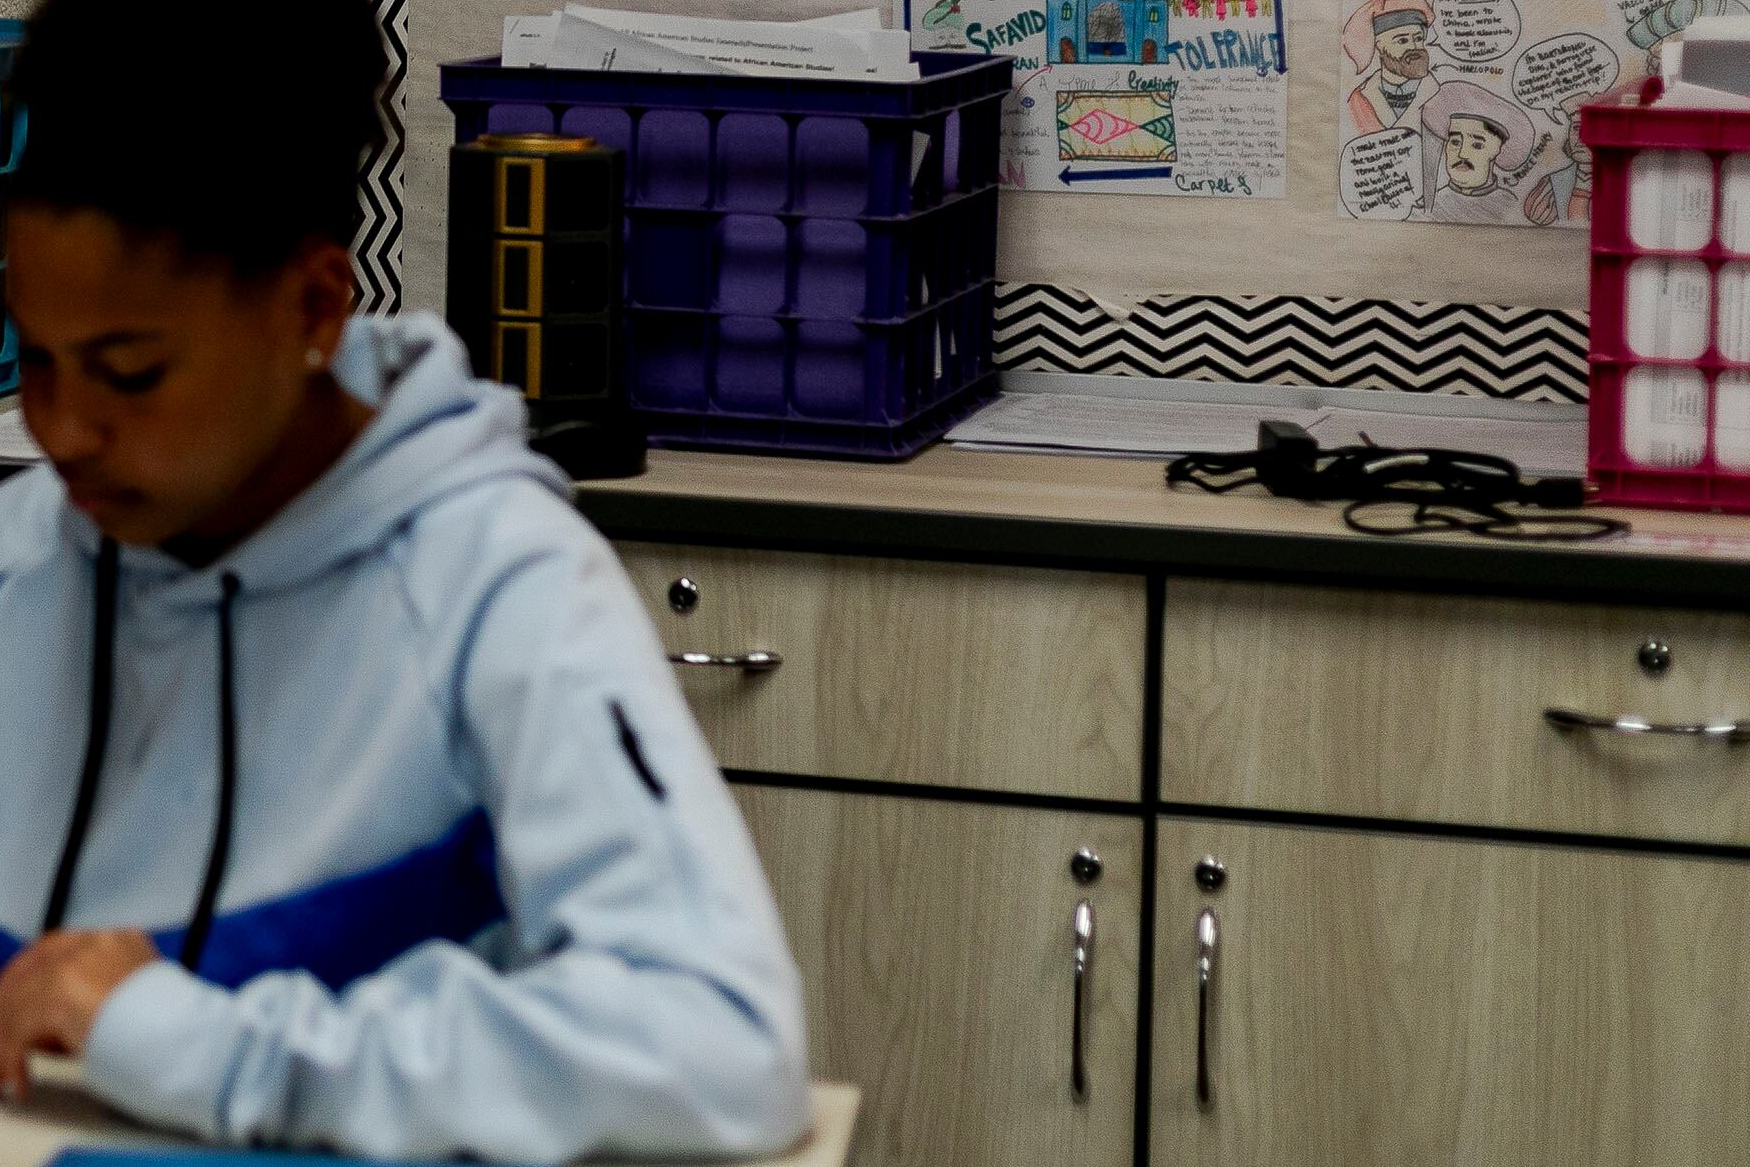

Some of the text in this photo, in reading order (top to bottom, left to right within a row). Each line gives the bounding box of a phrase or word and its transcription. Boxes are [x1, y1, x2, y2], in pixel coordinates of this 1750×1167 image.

[1458, 7, 1479, 18] been
[965, 9, 1048, 56] SAFAVID
[790, 44, 814, 54] Project
[708, 55, 733, 65] related
[742, 57, 769, 67] African
[769, 60, 804, 70] American
